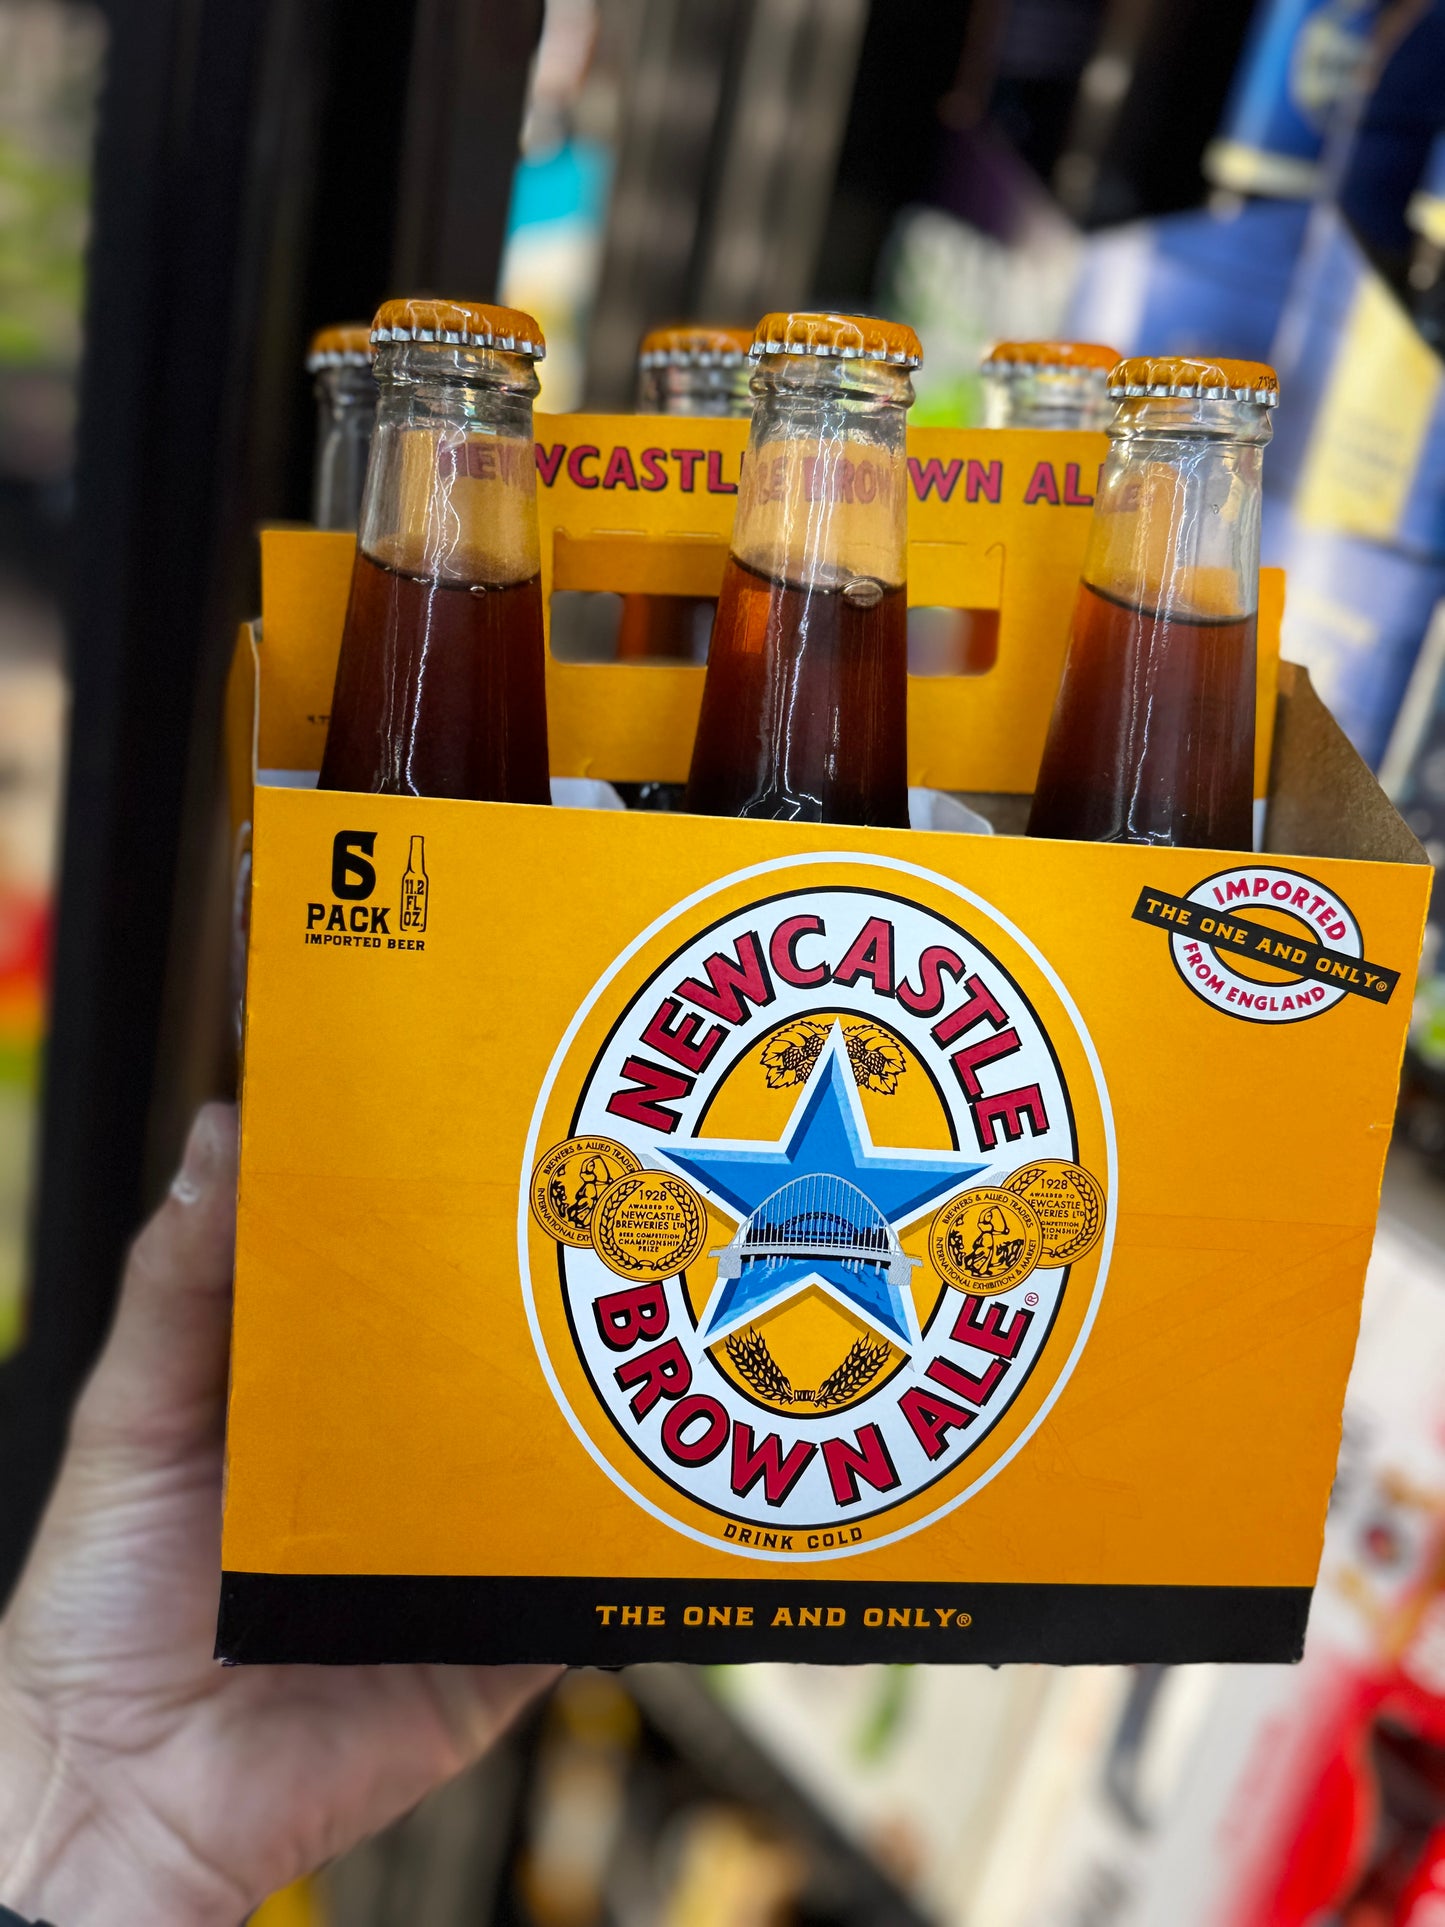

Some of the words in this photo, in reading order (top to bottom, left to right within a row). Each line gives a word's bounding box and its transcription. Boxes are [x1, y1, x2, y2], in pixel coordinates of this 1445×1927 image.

[332, 830, 378, 900] 6
[405, 879, 424, 895] 11.2
[306, 903, 391, 935] PACK
[404, 911, 424, 927] OZ.
[1213, 877, 1347, 942] IMPORTED
[305, 934, 381, 949] IMPORTED
[387, 939, 425, 951] BEER
[1146, 897, 1191, 925] THE
[1199, 917, 1248, 945] ONE
[1255, 937, 1307, 965] AND
[1183, 942, 1226, 994] FROM
[1225, 985, 1326, 1012] ENGLAND
[606, 913, 1052, 1153] NEWCASTLE
[543, 1144, 575, 1176] BREWERS
[576, 1143, 583, 1151] &
[585, 1142, 611, 1153] ALLIED
[611, 1148, 636, 1173] TRADER
[639, 1189, 667, 1201] 1928
[1041, 1178, 1068, 1190] 1928
[537, 1187, 576, 1240] INTERNATIONAL
[615, 1220, 669, 1230] BREWERIES
[621, 1210, 681, 1221] NEWCASTLE
[942, 1197, 973, 1225] BREWERS
[975, 1193, 982, 1201] &
[984, 1192, 1009, 1203] ALLIED
[1009, 1199, 1034, 1229] TRADERS
[618, 1238, 680, 1247] CHAMPIONSHIP
[636, 1232, 680, 1240] COMPETITION
[936, 1236, 971, 1288] INTERNATIONAL
[972, 1274, 1017, 1291] EXHIBITION
[1015, 1268, 1022, 1276] &
[1022, 1238, 1037, 1271] MARKET
[593, 1280, 902, 1508] BROWN
[723, 1523, 793, 1550] DRINK
[807, 1527, 863, 1549] COLD
[595, 1605, 666, 1627] THE
[683, 1605, 754, 1627] ONE
[771, 1606, 846, 1627] AND
